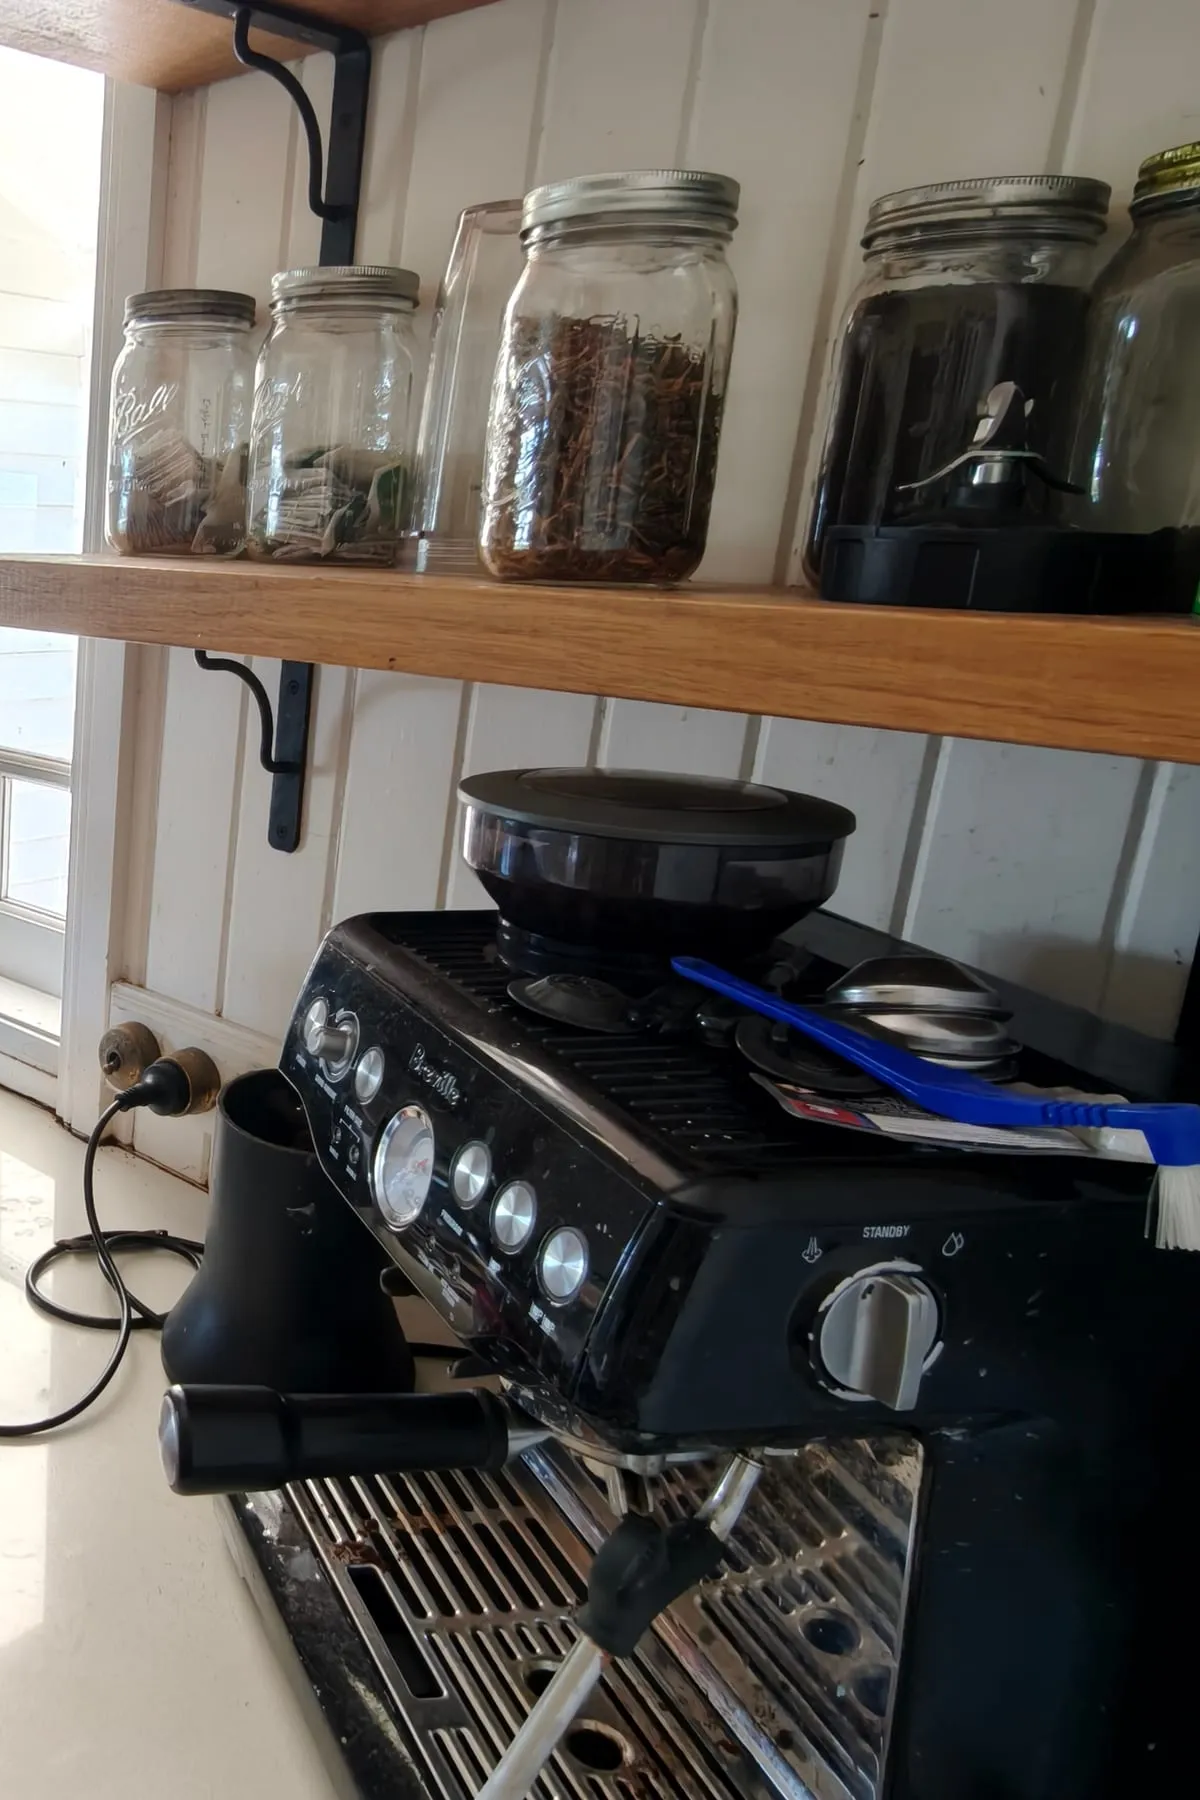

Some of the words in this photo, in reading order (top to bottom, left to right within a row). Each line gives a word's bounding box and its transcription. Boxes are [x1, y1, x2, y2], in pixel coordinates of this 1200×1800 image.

[114, 383, 179, 441] Ball
[408, 1042, 461, 1106] Breville
[862, 1225, 910, 1238] STANDBY
